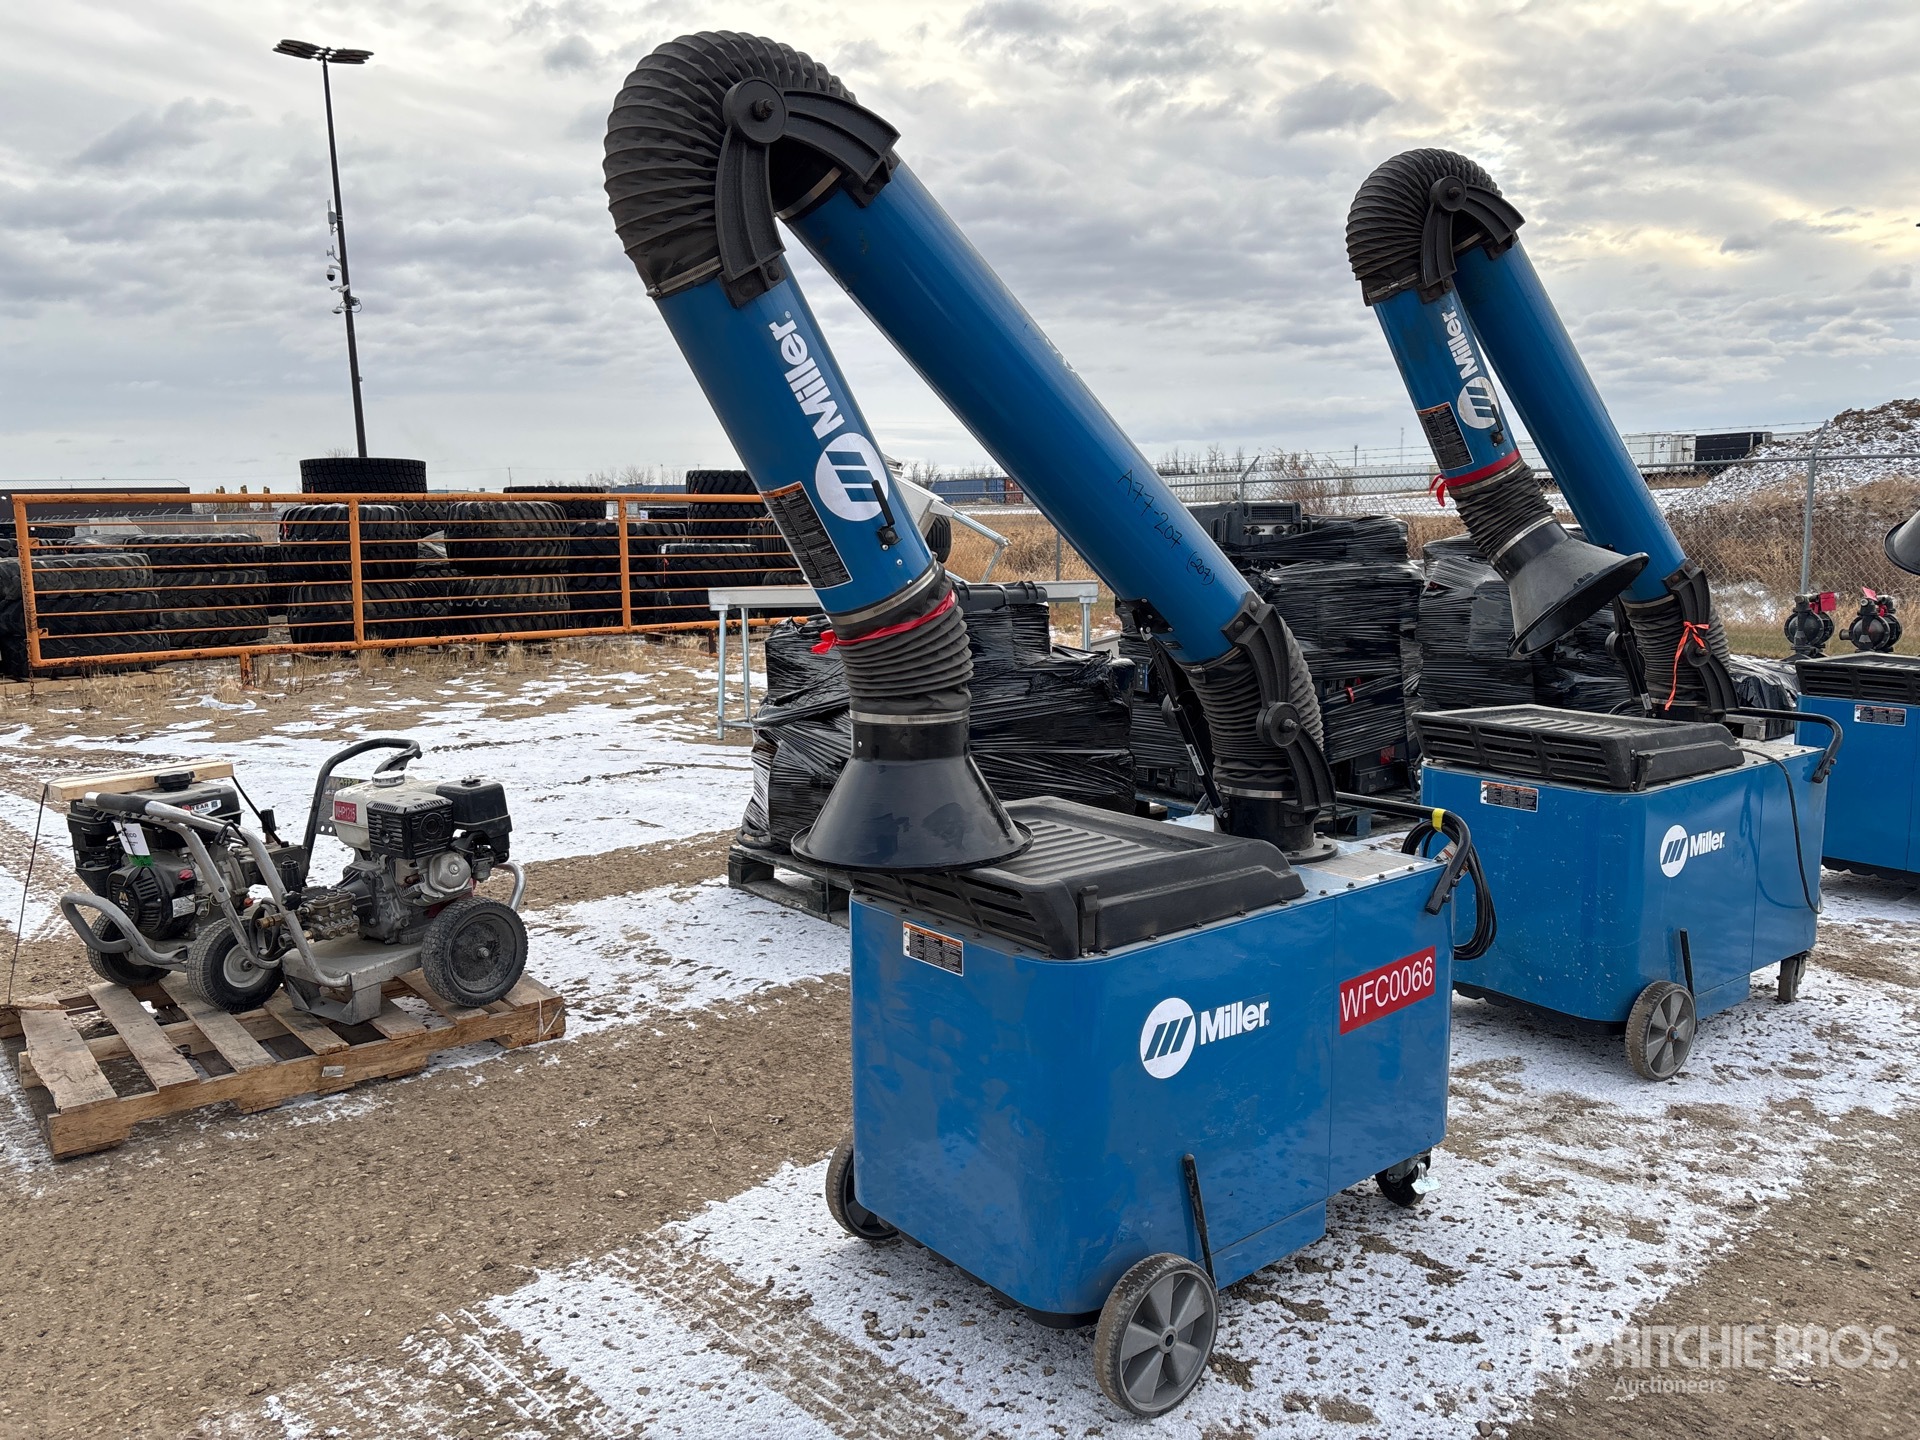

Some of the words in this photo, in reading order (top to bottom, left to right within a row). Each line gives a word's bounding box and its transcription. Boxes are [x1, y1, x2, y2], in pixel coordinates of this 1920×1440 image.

[768, 318, 846, 440] Miller
[1441, 310, 1479, 380] Miller
[1689, 831, 1726, 858] Miller
[1200, 1000, 1270, 1046] Miller
[1340, 955, 1433, 1023] WFC0066
